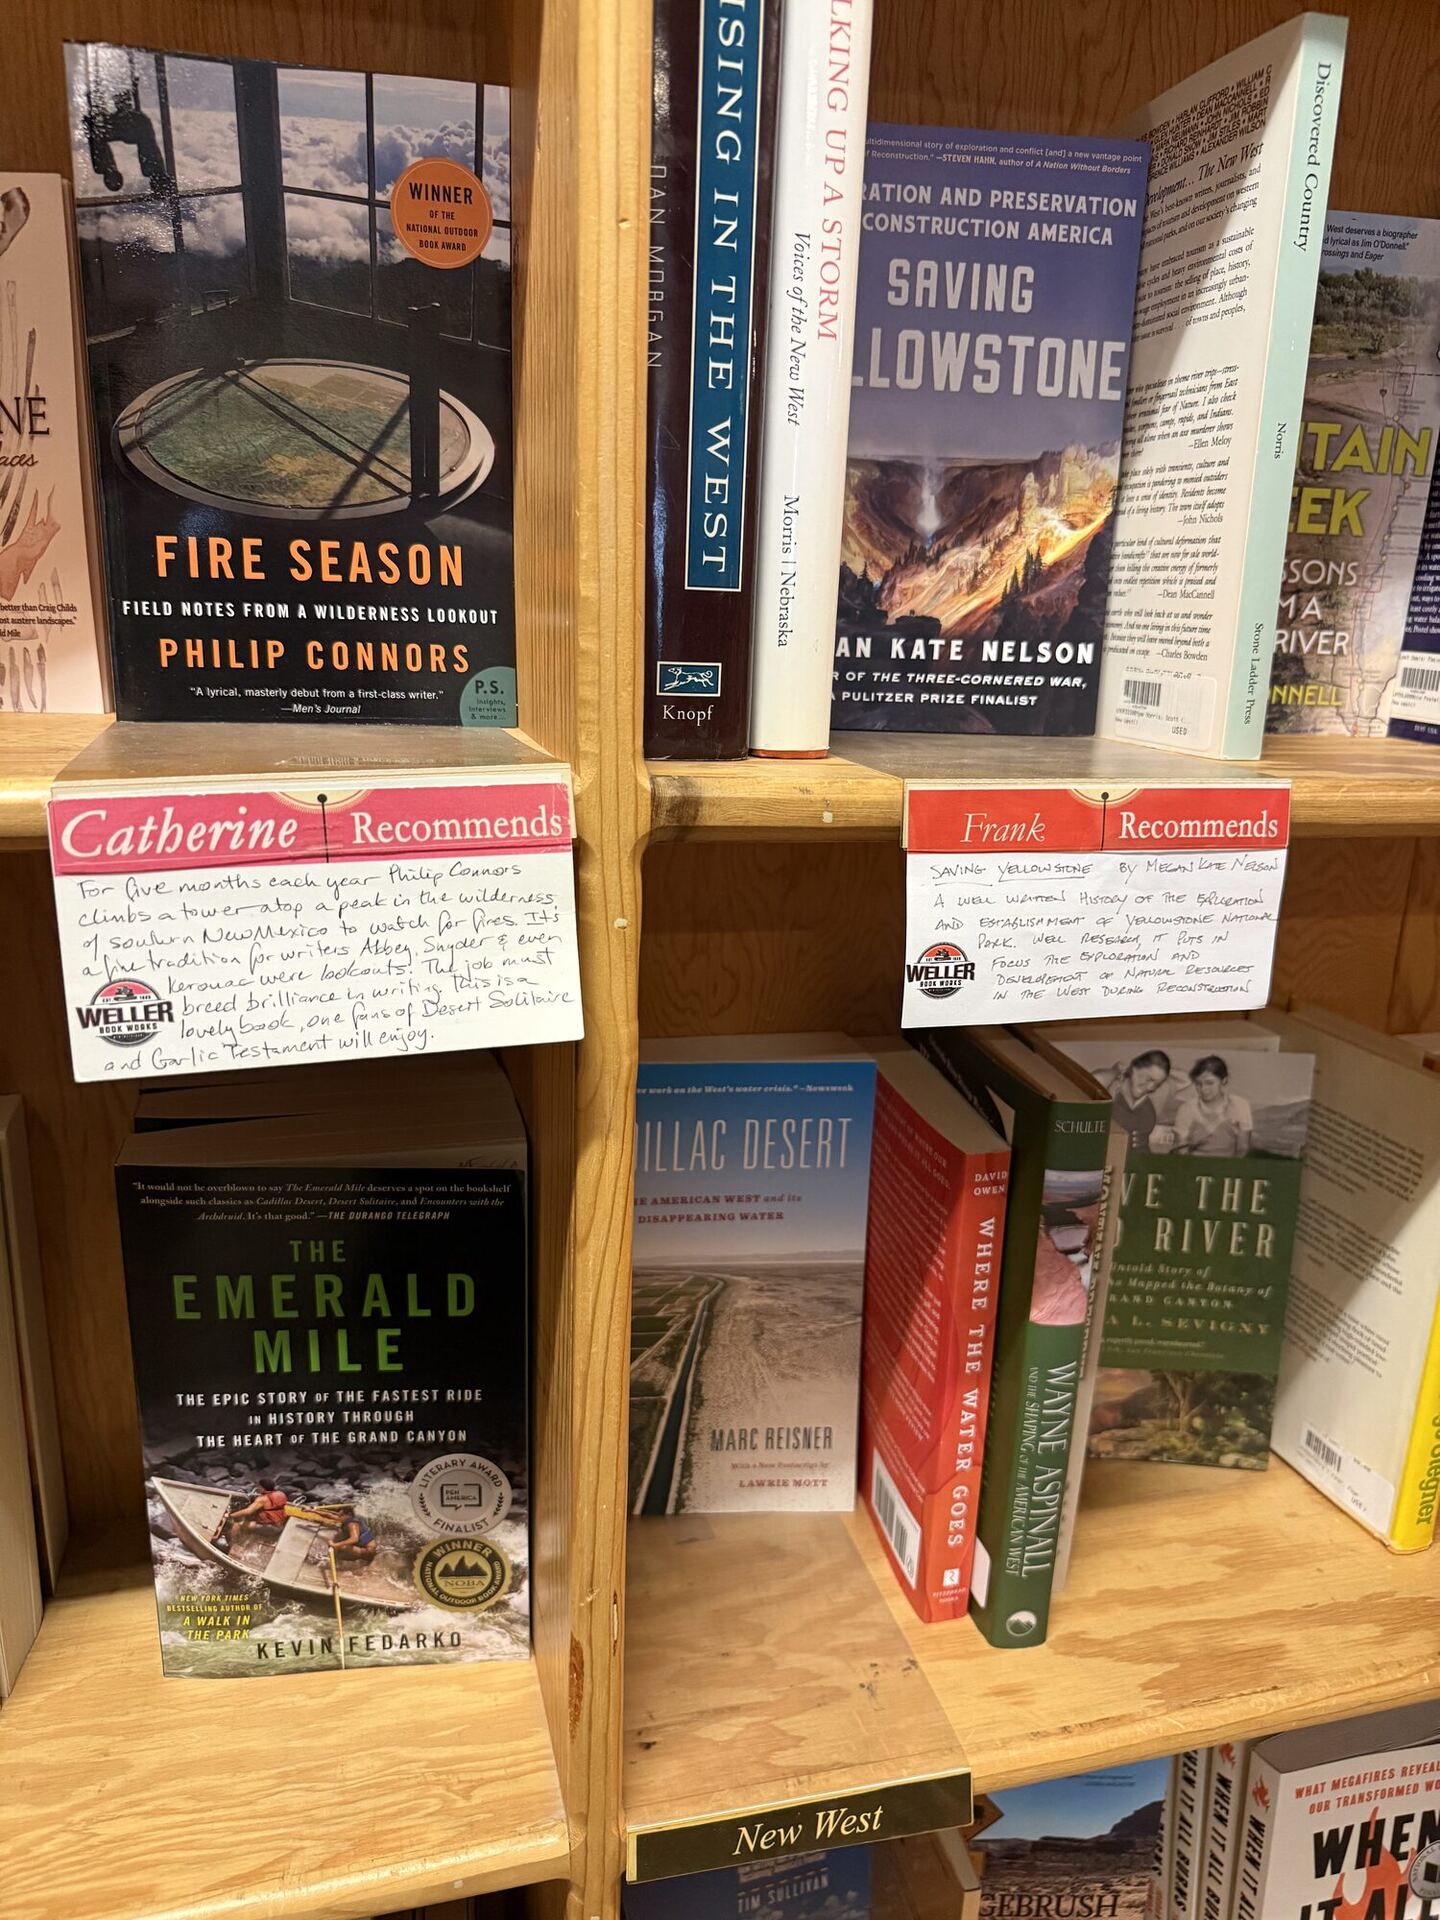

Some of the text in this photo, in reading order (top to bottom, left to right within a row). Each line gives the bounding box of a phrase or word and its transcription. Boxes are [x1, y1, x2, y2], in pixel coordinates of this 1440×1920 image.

[1102, 164, 1131, 174] Borders
[1293, 61, 1332, 252] Discovered Country
[817, 0, 852, 341] LKING UP A STORM
[409, 182, 474, 204] WINNER
[940, 186, 1137, 217] AND PRESERVATION
[429, 210, 456, 220] OF THE
[406, 223, 478, 237] NATIONAL OUTDOOR
[862, 213, 1113, 245] CONSTRUCTION AMERICA
[1382, 227, 1418, 239] biographer
[419, 239, 467, 251] BOOK AWARD
[1364, 252, 1384, 261] Eager
[647, 165, 667, 368] DAN MORGAN
[702, 0, 746, 573] ISING IN THE WEST
[887, 258, 1035, 314] SAVING
[786, 231, 811, 425] Voices of the New West
[1274, 422, 1287, 460] Norris
[155, 535, 464, 586] FIRE SEASON
[777, 495, 800, 648] Morris Nebraska
[57, 603, 77, 612] Childs
[122, 601, 498, 625] FIELD NOTES FROM A WILDERNESS LOOKOUT
[159, 638, 470, 673] PHILIP CONNORS
[836, 637, 1095, 665] AN KATE NELSON
[1275, 630, 1351, 656] RIVER
[846, 671, 1088, 690] OF THE THREE-CORNERED WAR,
[1243, 622, 1264, 725] Stone Ladder Press
[206, 687, 406, 699] lyrical, masterly debut from first-class
[475, 680, 504, 695] P.S.
[842, 691, 1038, 706] PULITZER PRIZE FINALIST
[324, 704, 361, 714] Journal
[662, 704, 715, 727] Knopf
[61, 805, 564, 858] Catherine Recommends
[960, 810, 1280, 844] Frank Recommends
[179, 860, 522, 893] months Philip Connors
[1146, 858, 1194, 873] MEGAN
[459, 887, 555, 906] wilderness
[905, 961, 976, 983] WELLER
[488, 990, 577, 1010] Solitaire
[75, 999, 175, 1029] WELLER
[99, 1022, 158, 1034] BOOK WORKS
[1054, 1119, 1106, 1133] SCHULTE
[743, 1118, 853, 1170] DESERT
[974, 1171, 1008, 1182] DAVID
[651, 1194, 761, 1206] AMERICAN WEST
[973, 1184, 1006, 1196] OWEN
[1196, 1175, 1271, 1215] THE
[638, 1211, 784, 1224] DISAPPEARING WATER
[1154, 1217, 1276, 1258] RIVER
[290, 1240, 346, 1263] THE
[172, 1273, 476, 1320] EMERALD
[1161, 1316, 1272, 1335] SEVIGNY
[253, 1328, 404, 1374] MILE
[947, 1217, 996, 1547] WHERE THE WATER GOES
[176, 1388, 484, 1407] THE EPIC STORY OF THE FASTEST RIDE
[248, 1409, 415, 1426] IN HISTORY THROUGH
[196, 1429, 468, 1449] THE HEART OF THE GRAND CANYON
[710, 1426, 833, 1451] MARC REISNER
[419, 1459, 503, 1489] LITERARY AWARD
[1020, 1361, 1077, 1578] WAYNE ASPINALL
[1005, 1400, 1040, 1577] SHAPING AMERICAN WEST
[433, 1517, 491, 1533] FINALIST
[433, 1540, 493, 1558] WINNER
[200, 1594, 222, 1602] YORK
[197, 1615, 250, 1626] WALK IN
[187, 1629, 250, 1640] THE PARK
[257, 1631, 462, 1660] KEVIN FEDARKO
[1295, 1761, 1440, 1799] WHAT MEGAFIRES REVEAL
[1309, 1783, 1419, 1815] OUR TRANSFORMED
[732, 1804, 884, 1856] New West
[1208, 1772, 1233, 1886] WHEN ALL
[1313, 1810, 1440, 1879] WHEN
[767, 1873, 830, 1906] SULLIVAN
[980, 1892, 1120, 1918] GEBRUSH
